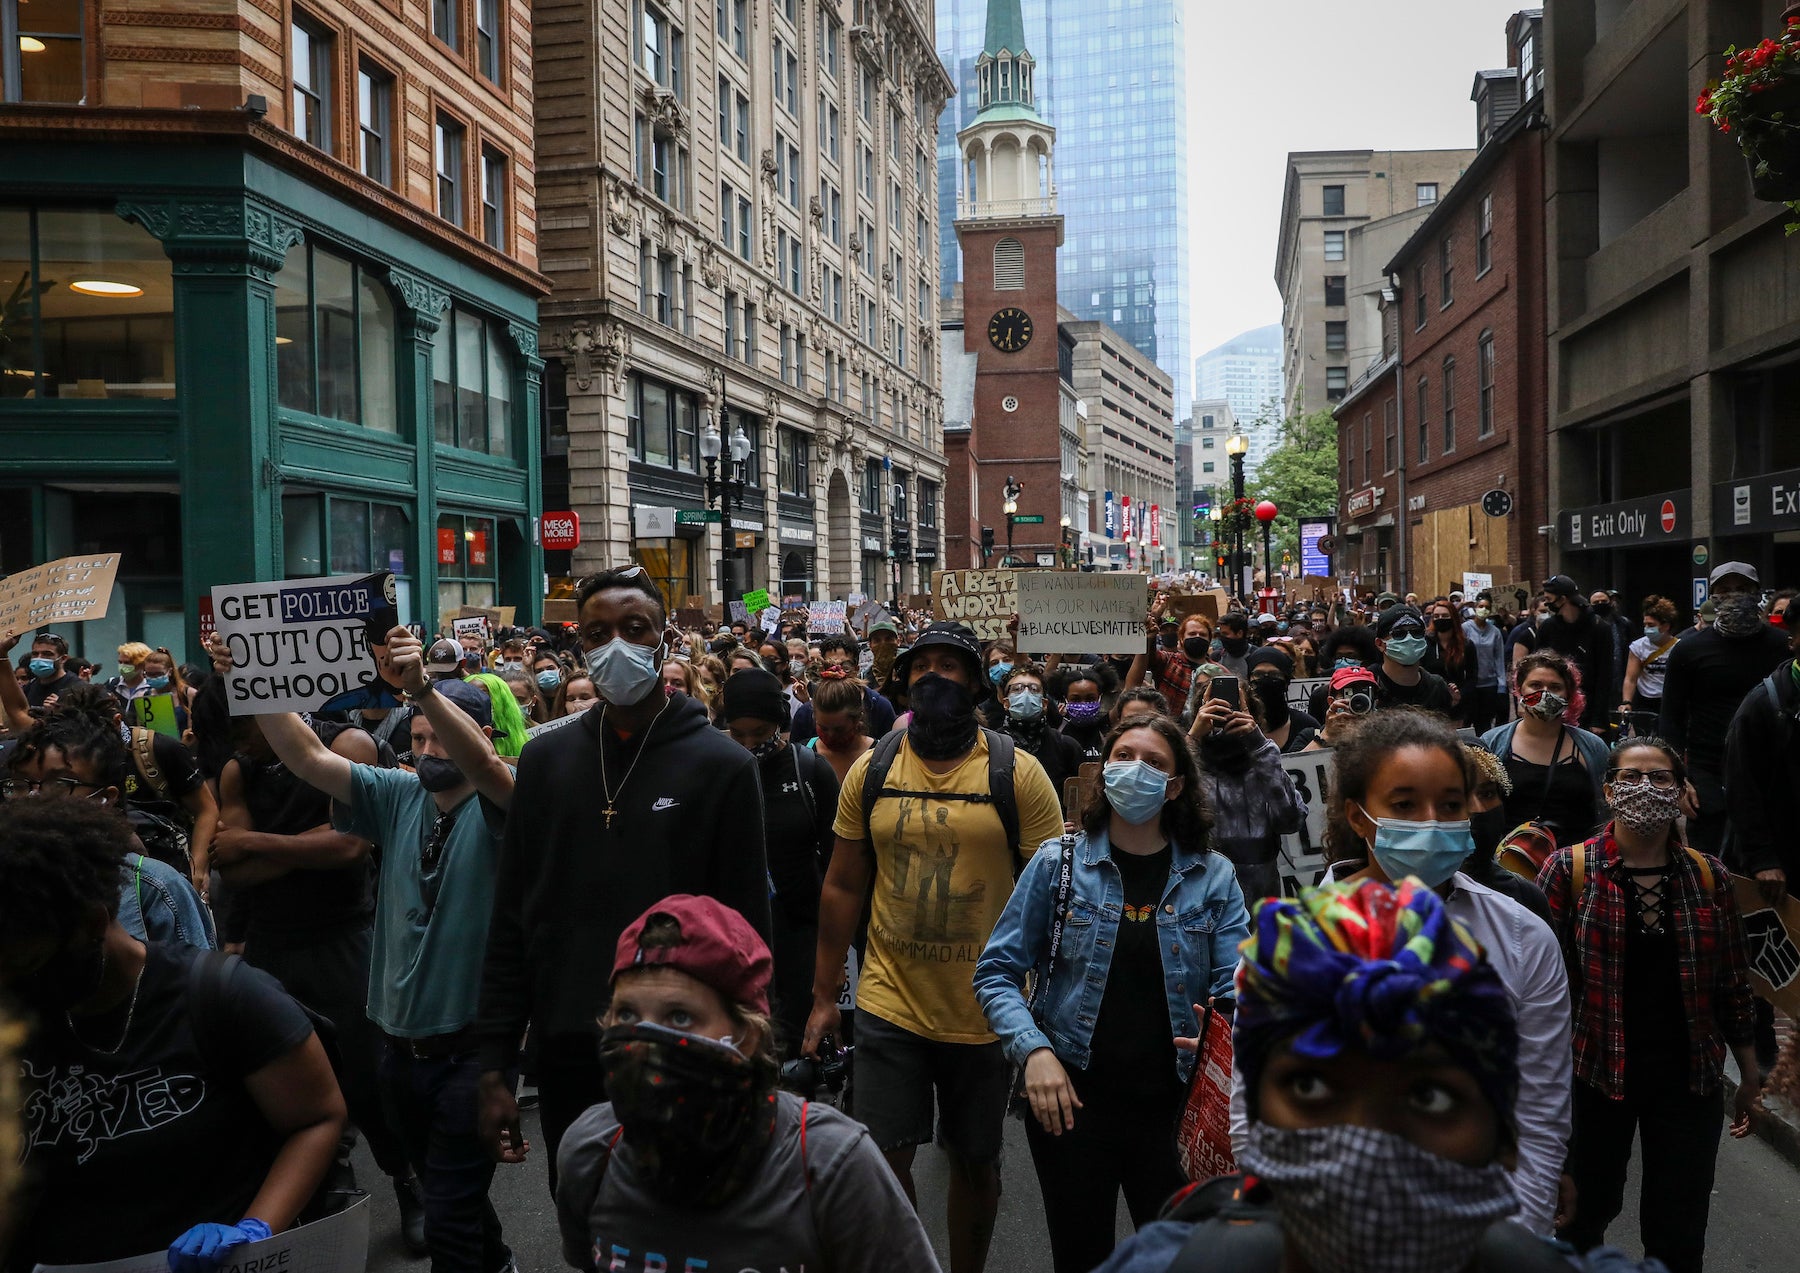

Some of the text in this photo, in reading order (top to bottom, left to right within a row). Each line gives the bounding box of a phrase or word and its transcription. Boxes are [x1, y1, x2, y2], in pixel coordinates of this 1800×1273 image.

[544, 519, 573, 529] MEGA
[683, 511, 706, 521] SPRING
[1592, 509, 1646, 537] Exit Only
[544, 528, 574, 538] MOBILE
[47, 556, 114, 577] POLICE!
[47, 570, 92, 587] ICE!
[939, 572, 962, 597] A
[1021, 576, 1039, 592] WE
[1044, 576, 1085, 591] WANT
[1696, 583, 1705, 604] P
[29, 598, 97, 618] DETENTION
[220, 589, 370, 621] GET POLICE
[1024, 595, 1140, 615] SAY OUR NAMES!
[1020, 620, 1146, 636] #BLACKLIVESMATTER
[226, 625, 369, 669] OUT OF
[143, 697, 154, 722] B
[655, 797, 674, 806] NIKE
[1058, 864, 1071, 900] adidas
[875, 925, 951, 963] MUHAMMAD
[1050, 920, 1062, 957] adidas
